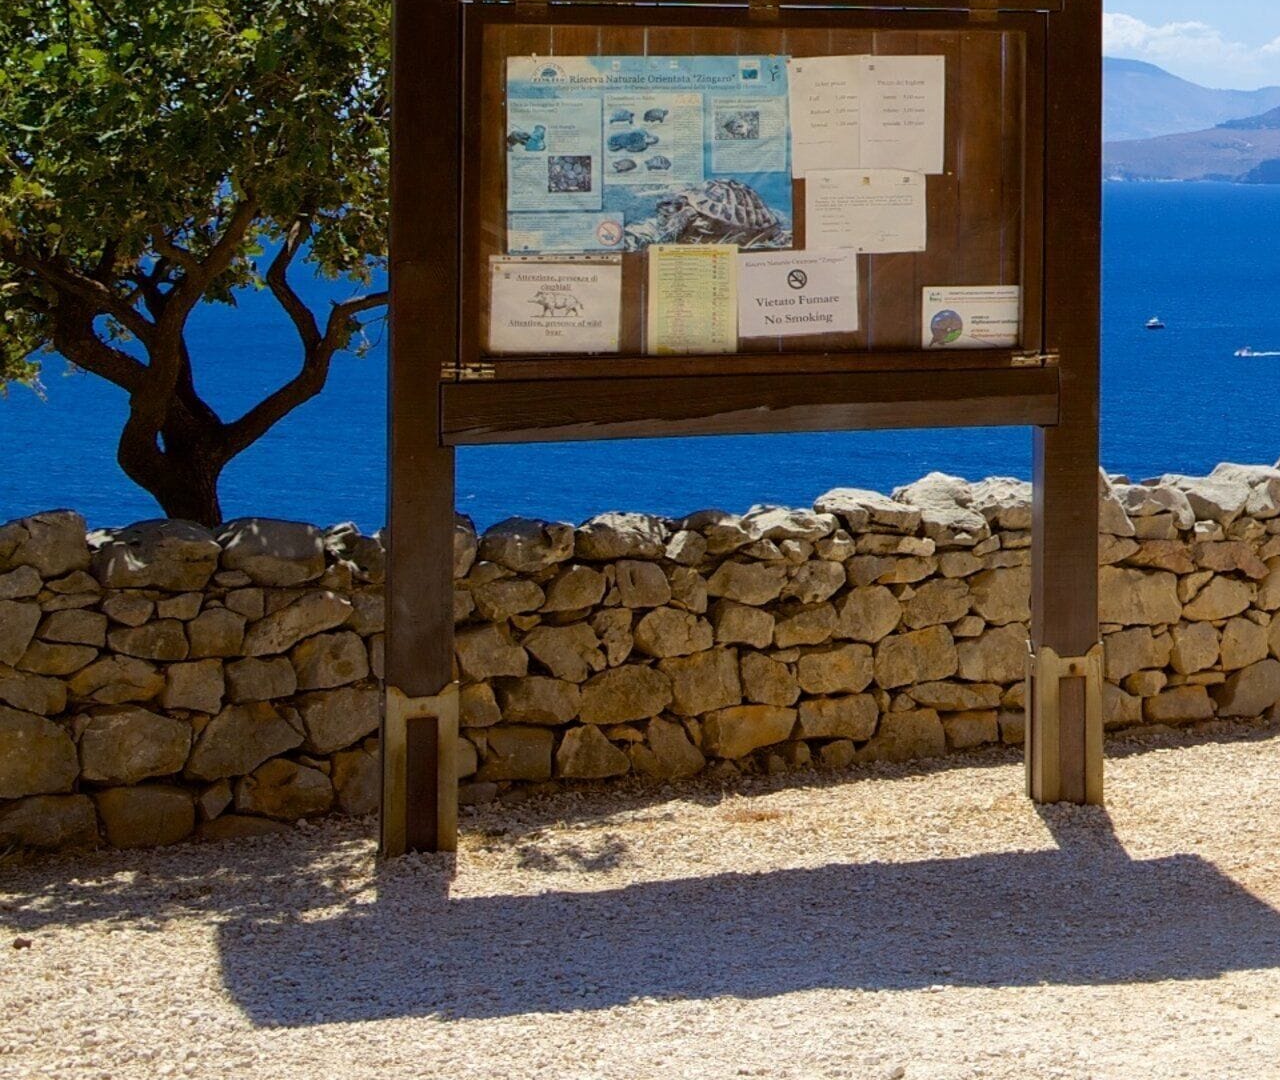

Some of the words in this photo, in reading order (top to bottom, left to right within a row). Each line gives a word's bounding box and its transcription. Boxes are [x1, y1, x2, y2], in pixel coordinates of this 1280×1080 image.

[569, 74, 603, 84] Riserva
[606, 74, 645, 84] Naturale
[647, 74, 691, 84] Orientata
[756, 297, 796, 307] Vietato
[798, 295, 840, 305] Fumare
[764, 315, 782, 325] No
[785, 312, 833, 323] Smoking
